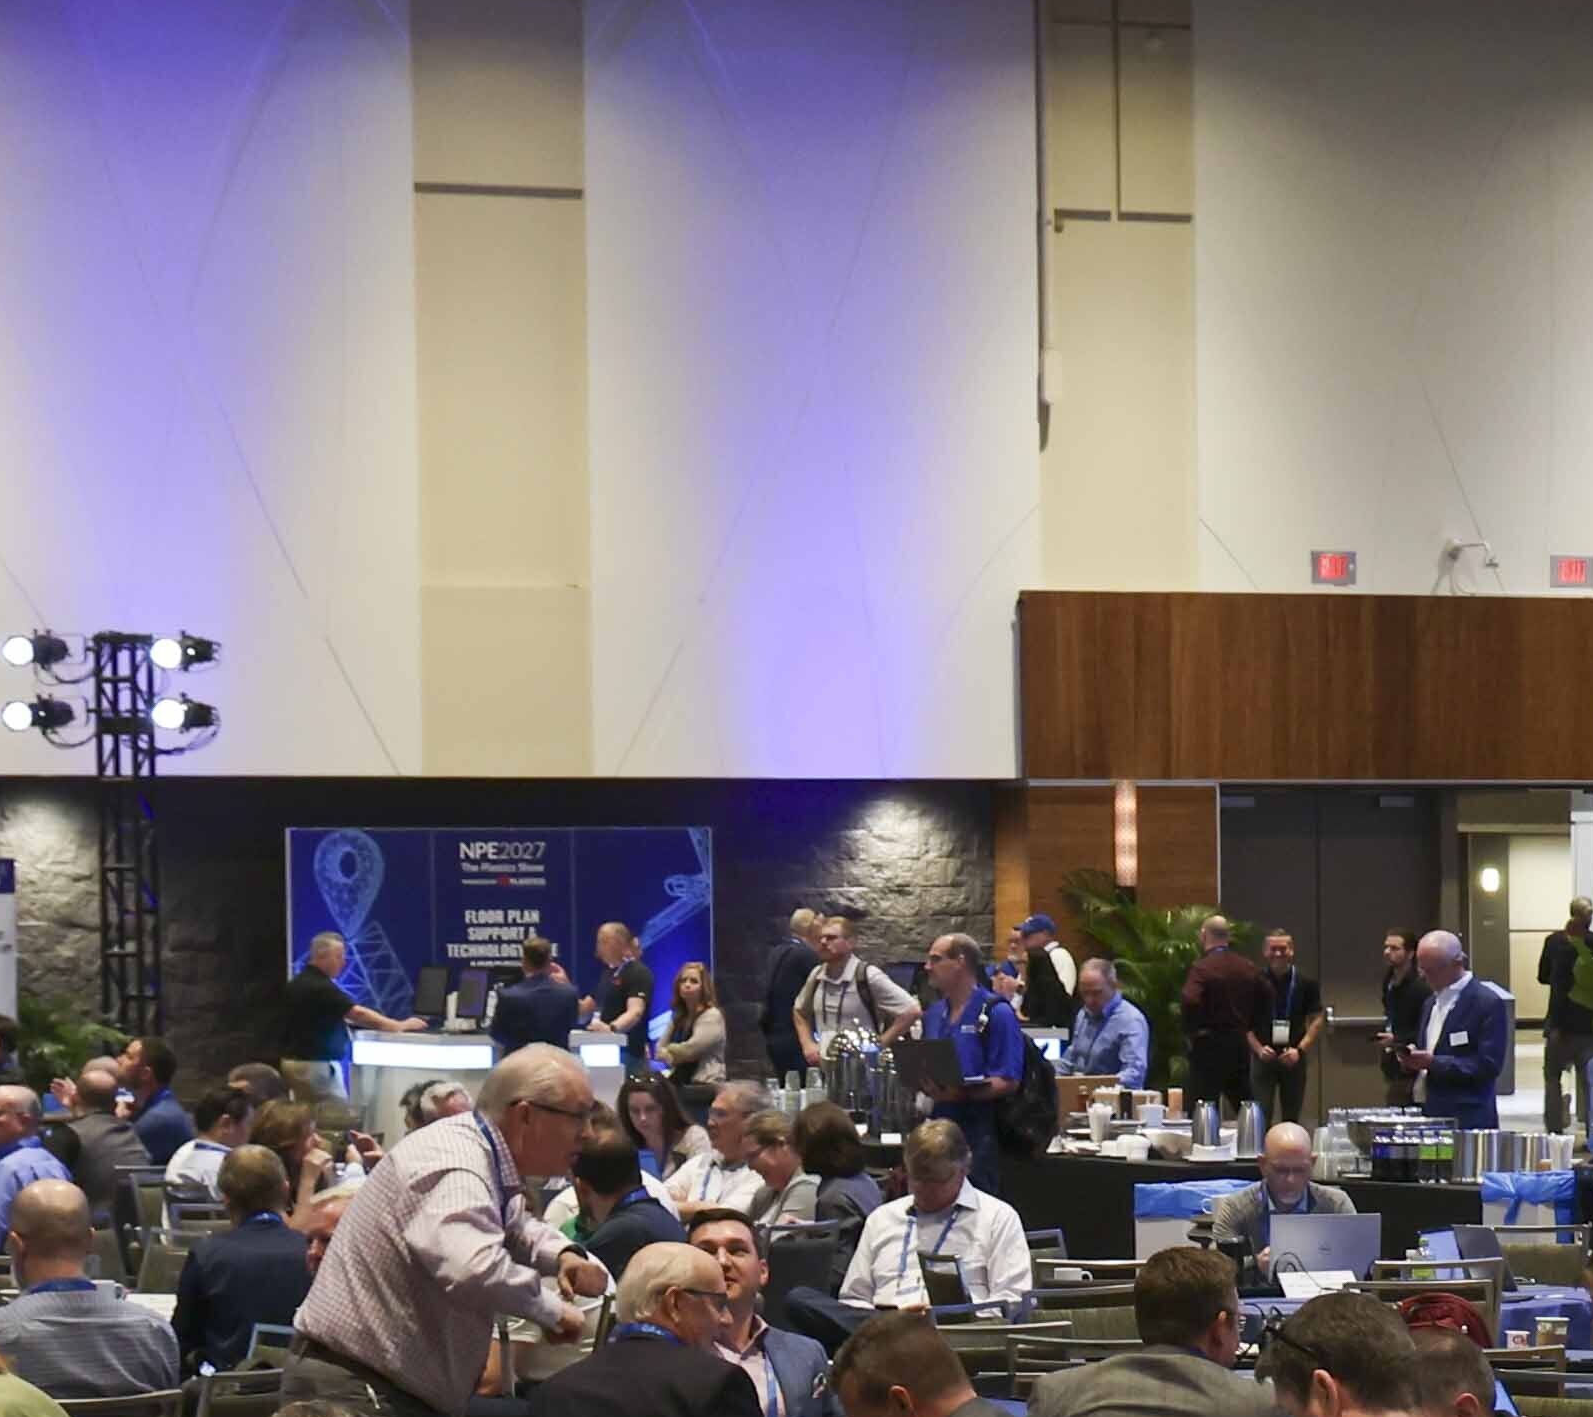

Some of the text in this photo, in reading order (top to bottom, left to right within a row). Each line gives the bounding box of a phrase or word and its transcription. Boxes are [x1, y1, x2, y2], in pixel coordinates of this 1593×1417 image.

[459, 841, 545, 859] NPE2027
[464, 909, 540, 924] FLOOR PLAN
[467, 926, 525, 941] SUPPORT
